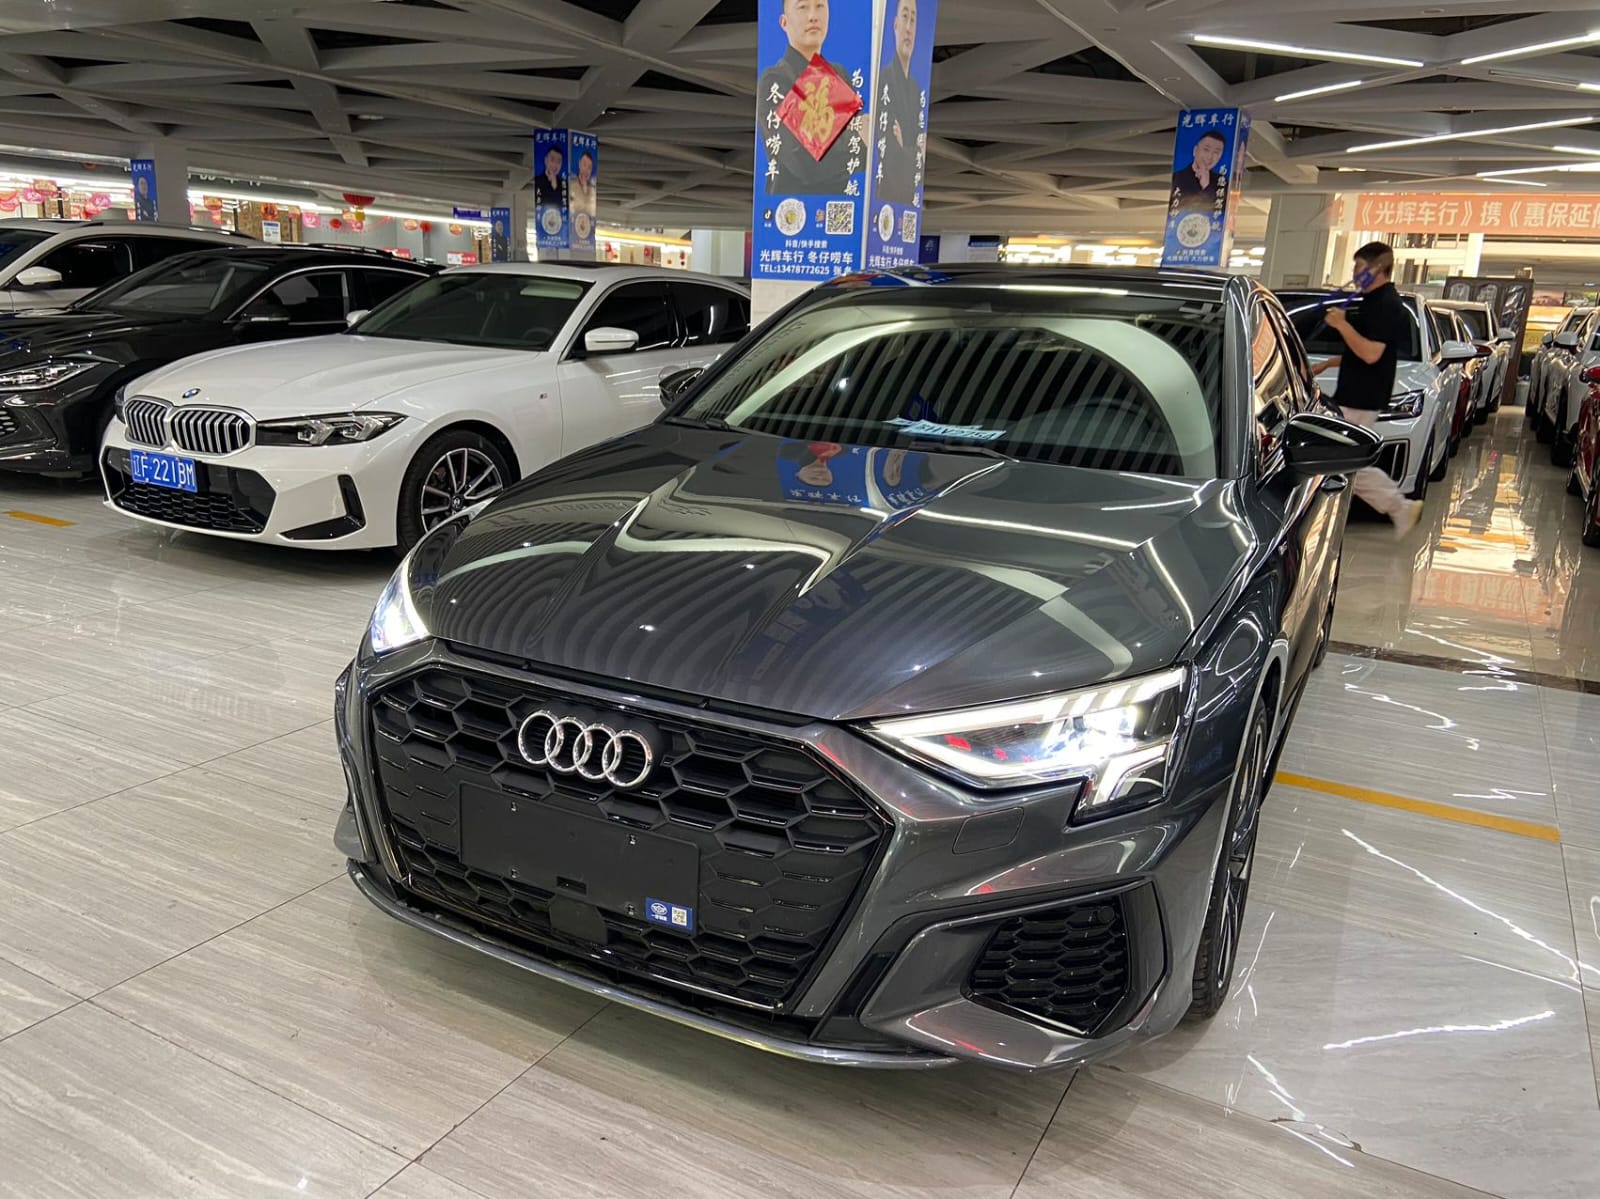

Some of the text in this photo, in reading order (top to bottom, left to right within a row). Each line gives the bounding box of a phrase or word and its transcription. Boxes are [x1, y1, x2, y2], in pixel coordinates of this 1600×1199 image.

[764, 82, 784, 181] 冬仔唠车
[843, 68, 864, 197] 为保驾护航
[759, 249, 803, 264] 光辉车行
